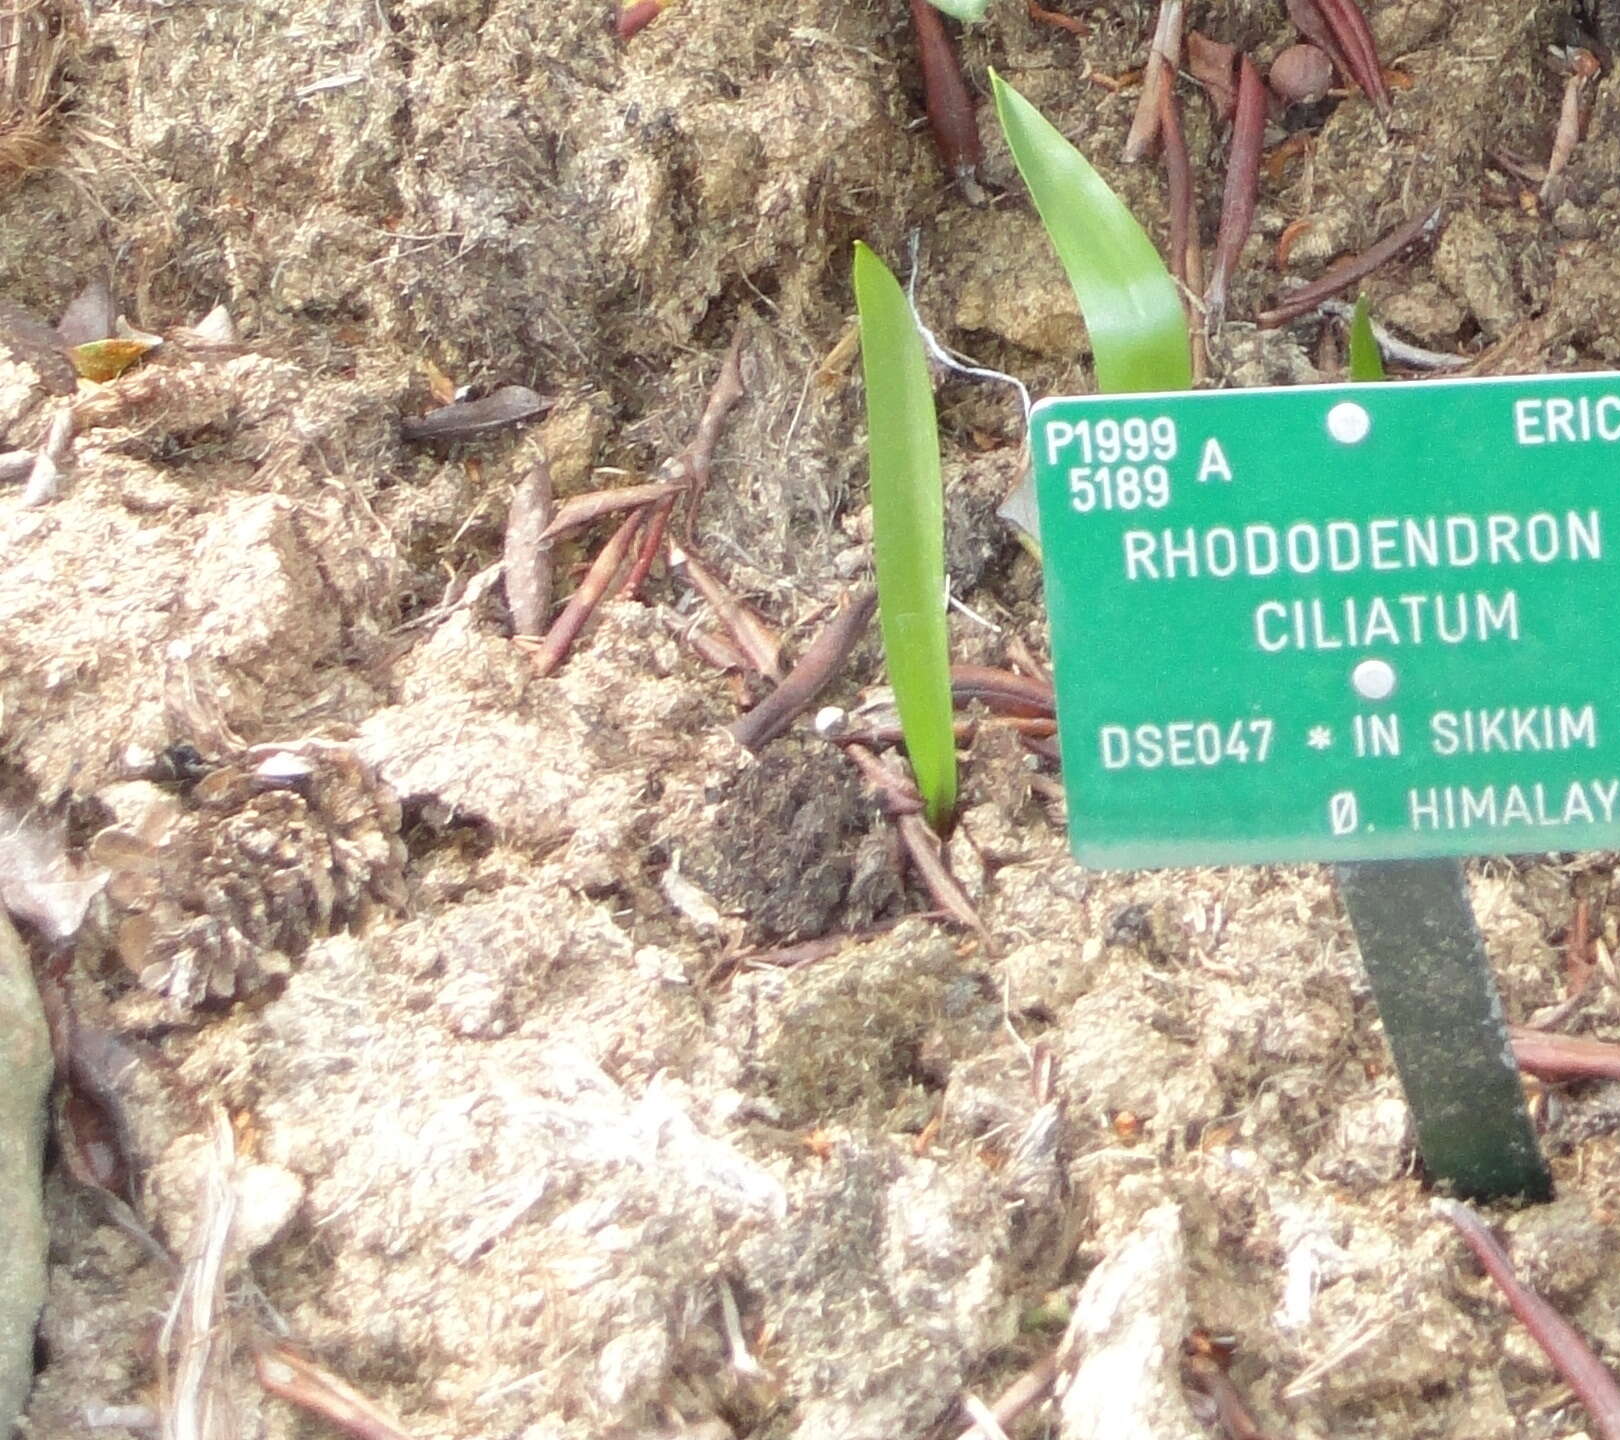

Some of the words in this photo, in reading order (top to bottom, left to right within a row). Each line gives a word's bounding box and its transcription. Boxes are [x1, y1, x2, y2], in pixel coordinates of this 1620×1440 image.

[1046, 416, 1178, 466] P1999
[1197, 438, 1232, 482] A
[1069, 466, 1171, 513] 5189
[1123, 509, 1602, 580] RHODODENDRON
[1254, 591, 1519, 652] CILIATUM
[1100, 719, 1275, 770] DSE047
[1353, 714, 1401, 757] IN
[1431, 705, 1597, 753] SIKKIM
